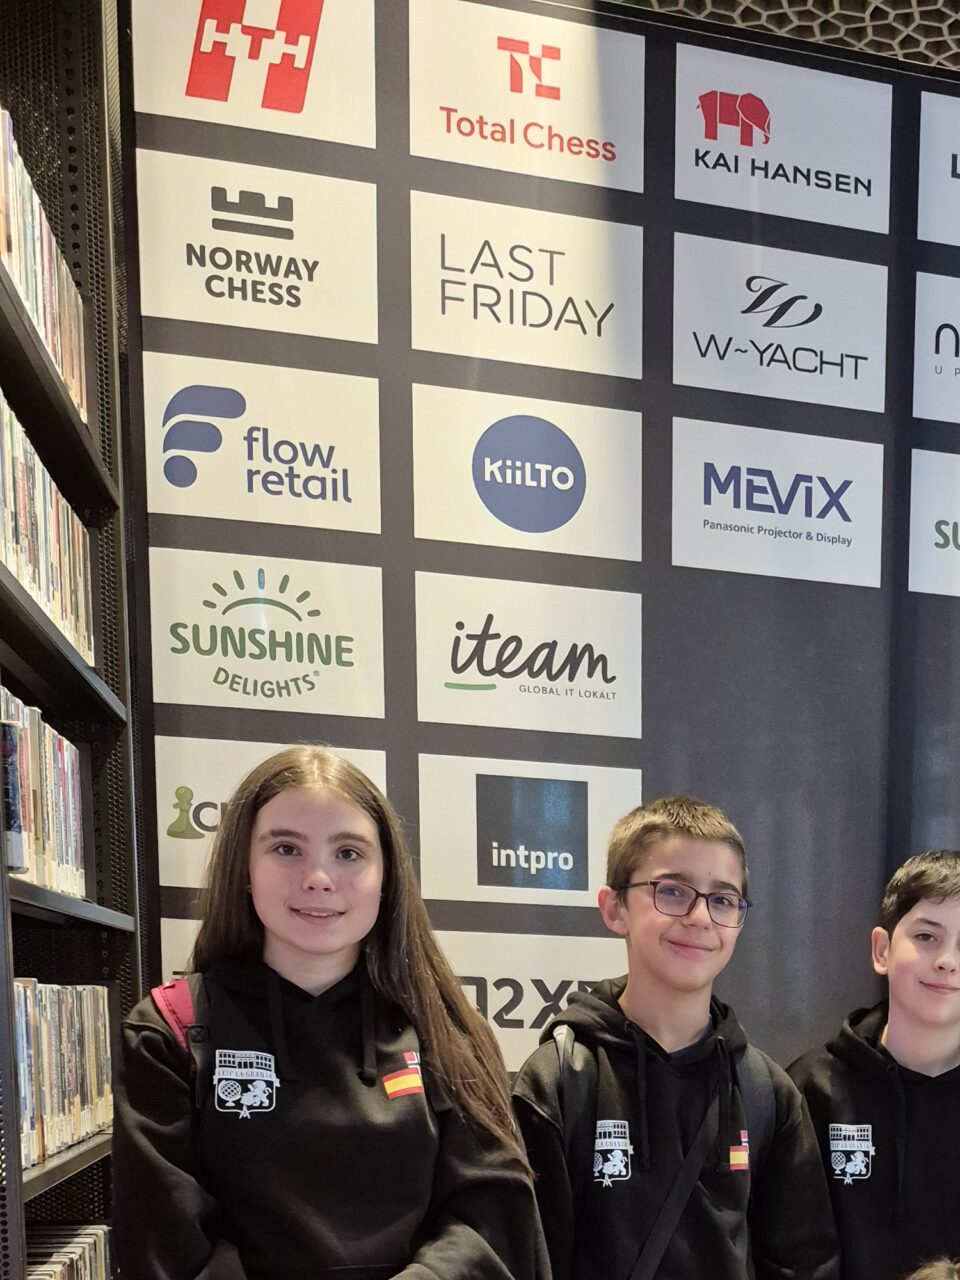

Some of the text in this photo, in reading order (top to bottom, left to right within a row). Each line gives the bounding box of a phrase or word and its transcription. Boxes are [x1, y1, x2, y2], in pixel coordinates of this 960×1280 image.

[439, 106, 617, 161] Total Chess
[694, 149, 872, 197] KAI HANSEN
[186, 243, 319, 282] NORWAY
[441, 233, 565, 286] LAST
[205, 275, 301, 308] CHESS
[441, 279, 614, 337] FRIDAY
[243, 426, 335, 469] flow
[246, 465, 352, 503] retail
[702, 519, 852, 548] Panasonic Projector & Display
[170, 622, 354, 668] SUNSHINE
[451, 613, 616, 683] iteam
[212, 667, 317, 698] DELIGHTS
[519, 684, 617, 700] GLOBAL IT LOKALT
[492, 842, 573, 875] intpro
